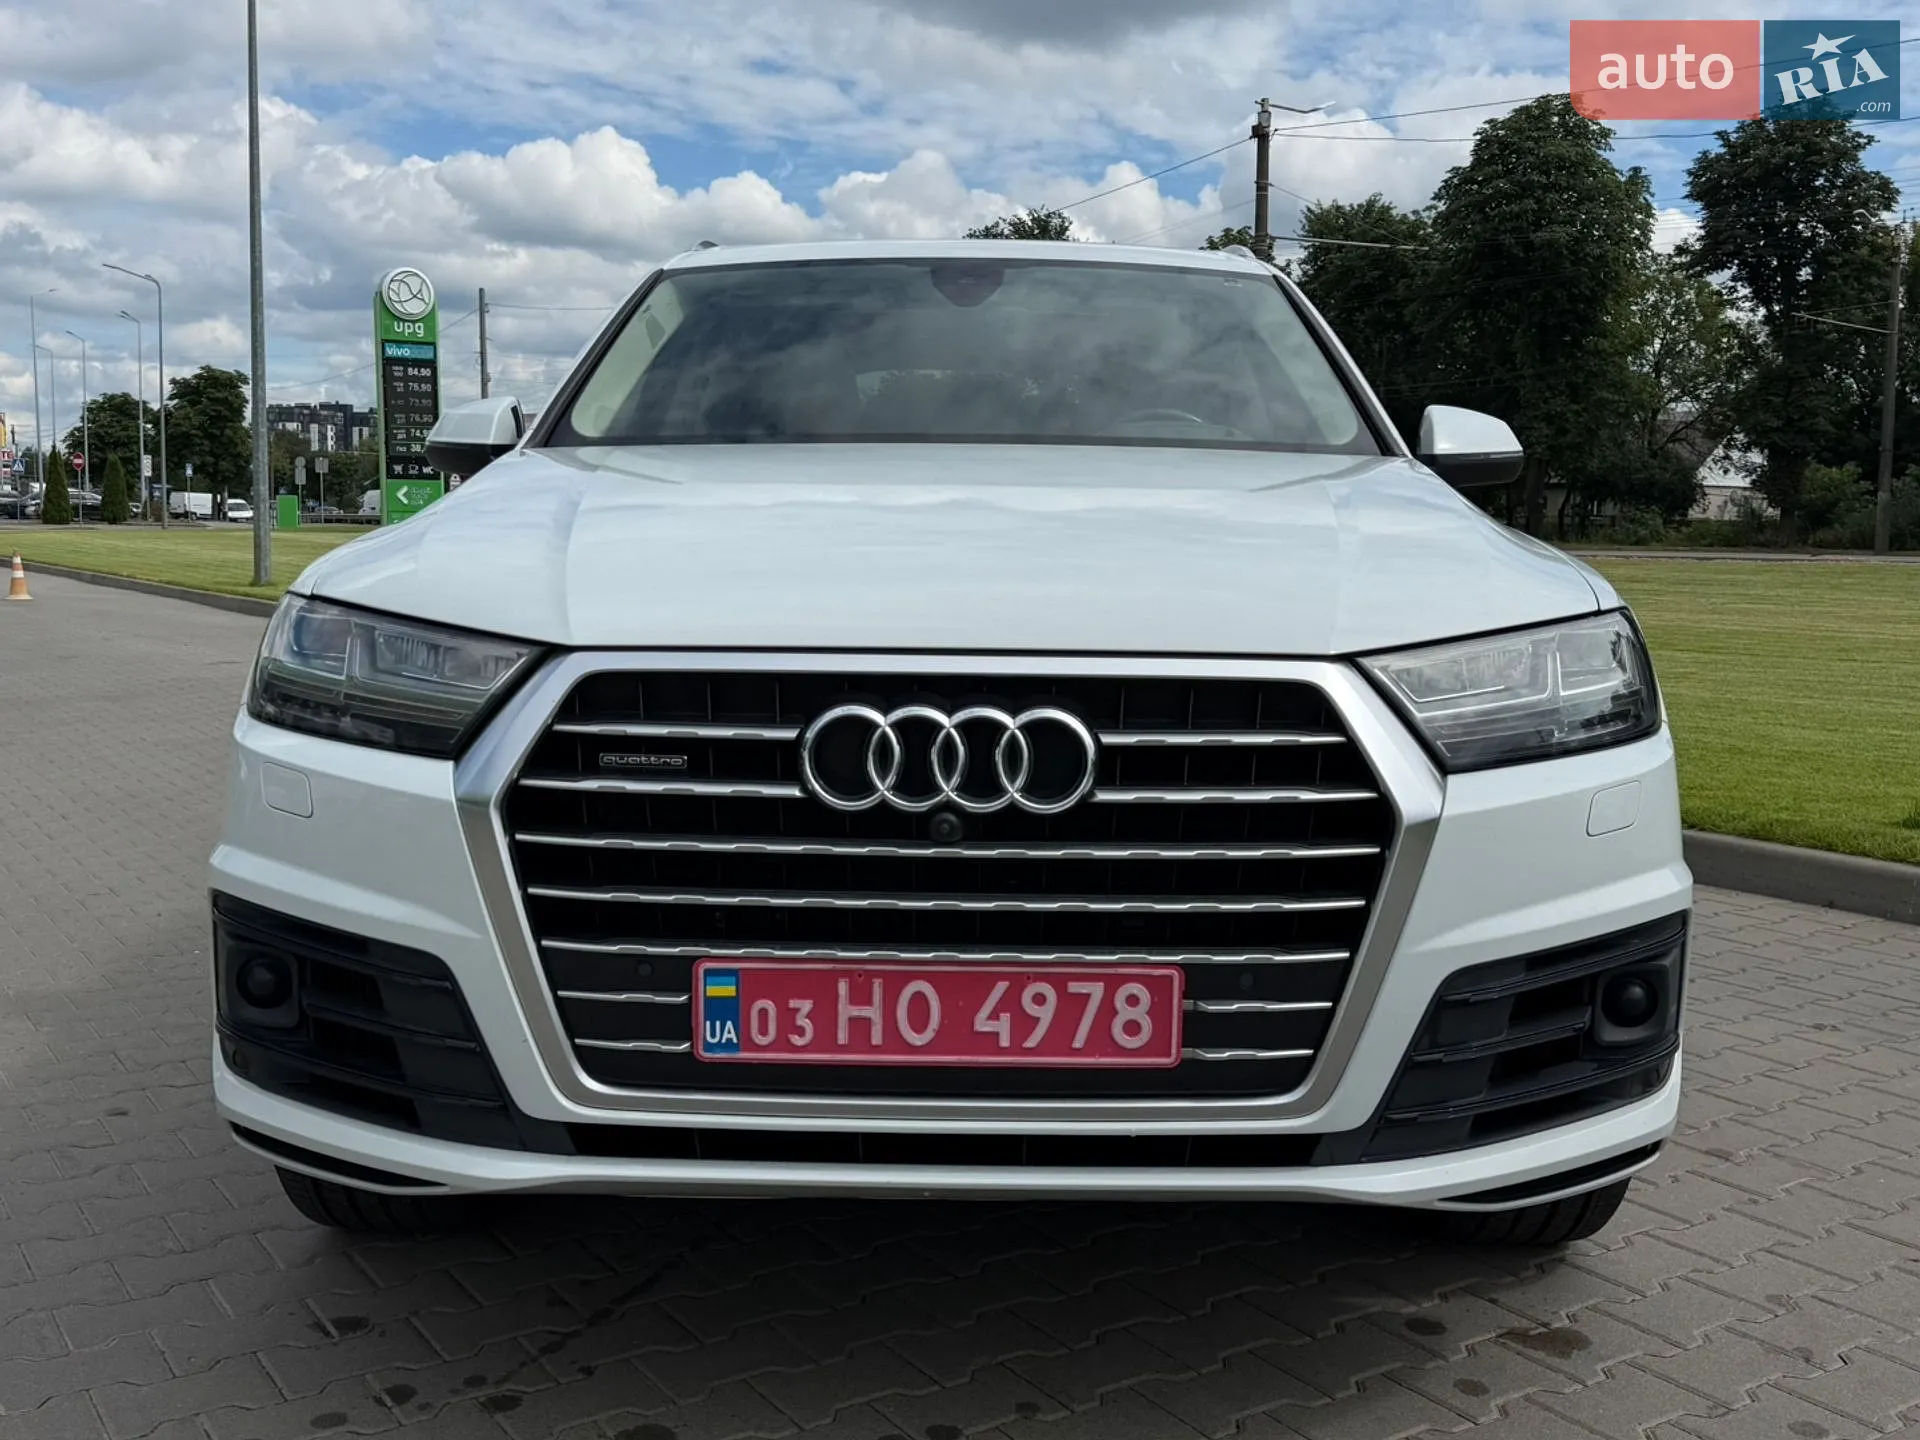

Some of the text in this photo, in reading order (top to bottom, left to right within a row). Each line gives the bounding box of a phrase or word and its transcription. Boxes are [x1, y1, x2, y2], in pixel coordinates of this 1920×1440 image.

[394, 321, 425, 337] upg
[386, 345, 411, 356] vivo
[603, 755, 683, 766] quattro
[749, 977, 1154, 1050] 03 HO 4978
[705, 1020, 738, 1044] UA
